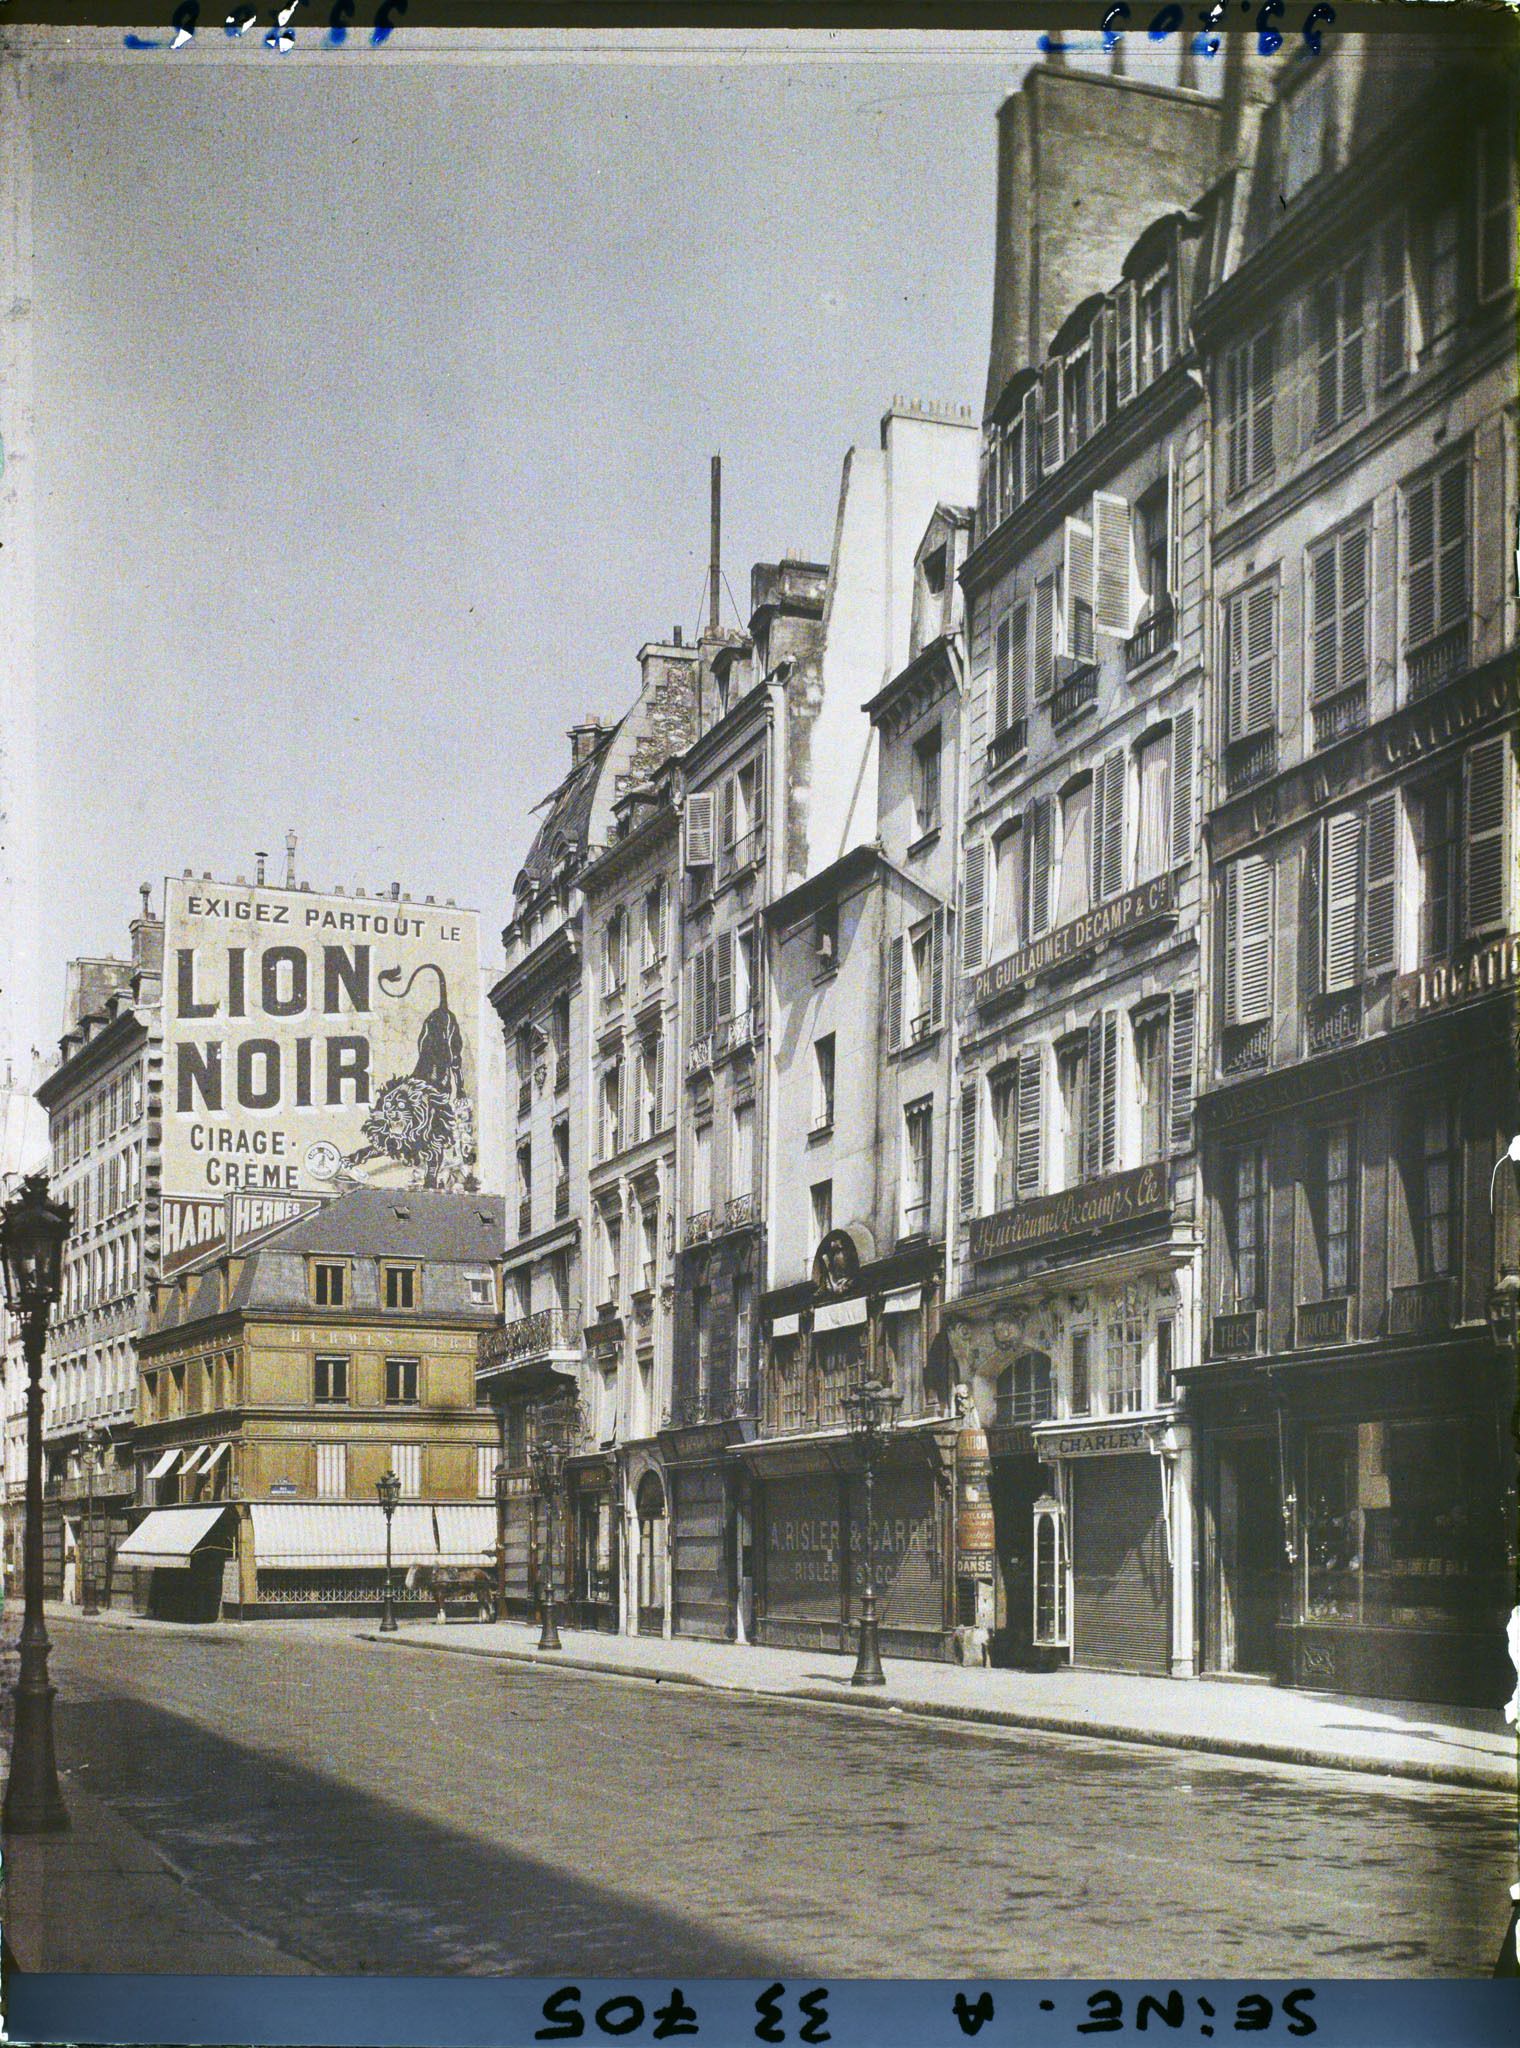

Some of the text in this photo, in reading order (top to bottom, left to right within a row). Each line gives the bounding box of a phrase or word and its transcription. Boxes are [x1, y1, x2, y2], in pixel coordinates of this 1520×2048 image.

[188, 896, 461, 942] EXIGEZ PARTOUT LE
[1075, 898, 1132, 948] DECAMP
[1134, 899, 1145, 918] &
[176, 944, 371, 1019] LION
[176, 1035, 372, 1113] NOIR
[206, 1157, 299, 1190] CRÈME
[1059, 1432, 1143, 1453] CHARLEY
[957, 1560, 993, 1572] DANSE
[533, 1987, 699, 2041] 705
[753, 1982, 833, 2044] 33
[953, 1990, 995, 2037] A
